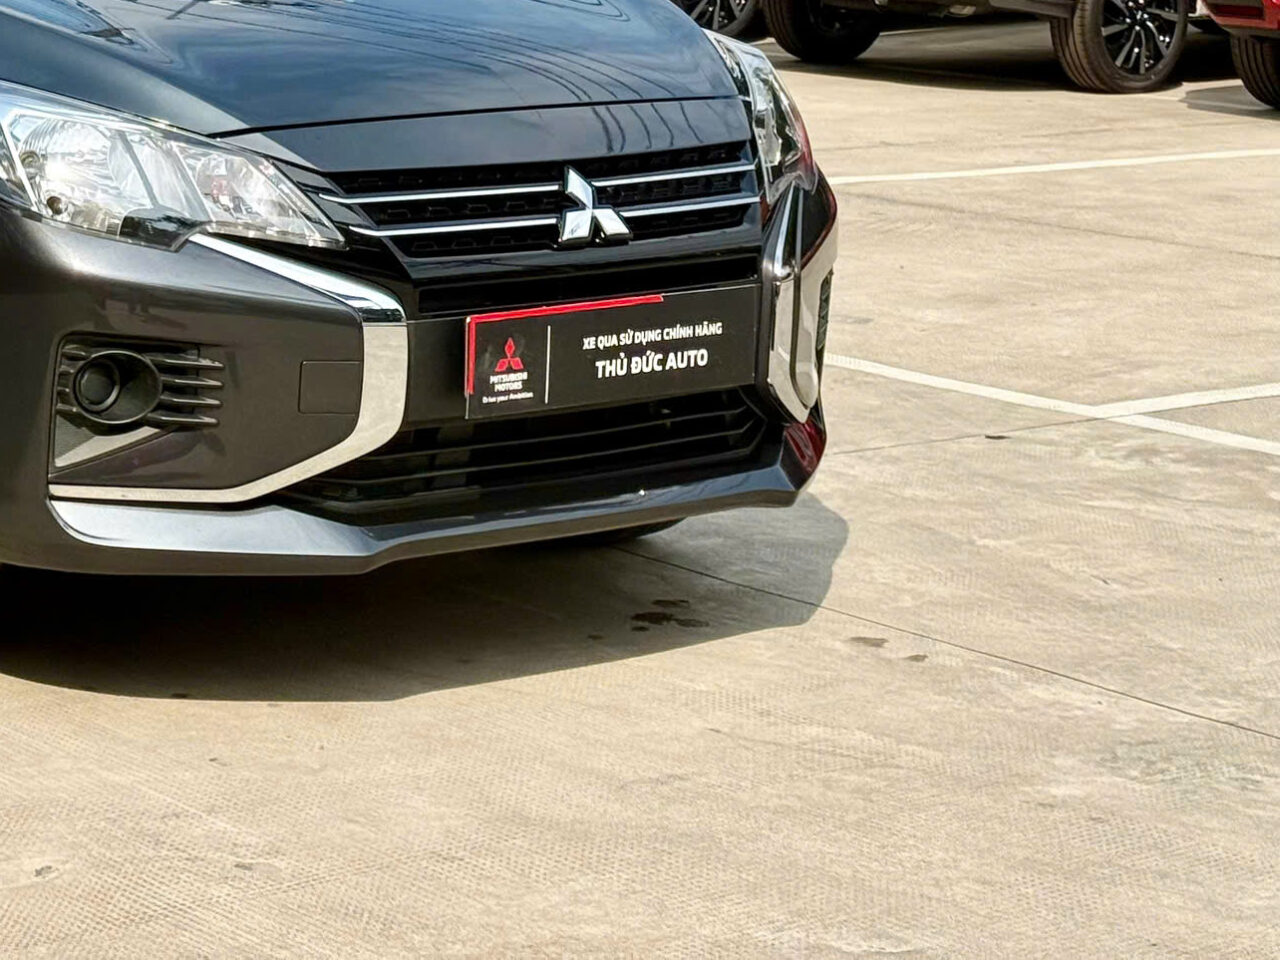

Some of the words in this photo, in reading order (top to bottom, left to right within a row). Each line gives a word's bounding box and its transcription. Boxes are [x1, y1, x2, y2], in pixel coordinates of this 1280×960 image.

[582, 336, 596, 350] XE
[597, 334, 618, 350] QUA
[634, 329, 662, 346] DỤNG
[663, 324, 693, 340] CHÍNH
[694, 321, 723, 337] HÃNG
[595, 352, 628, 379] THỦ
[630, 349, 663, 375] ĐỨC
[665, 348, 709, 371] AUTO
[490, 371, 529, 385] MITSUBISHI
[494, 381, 523, 392] MOTORS
